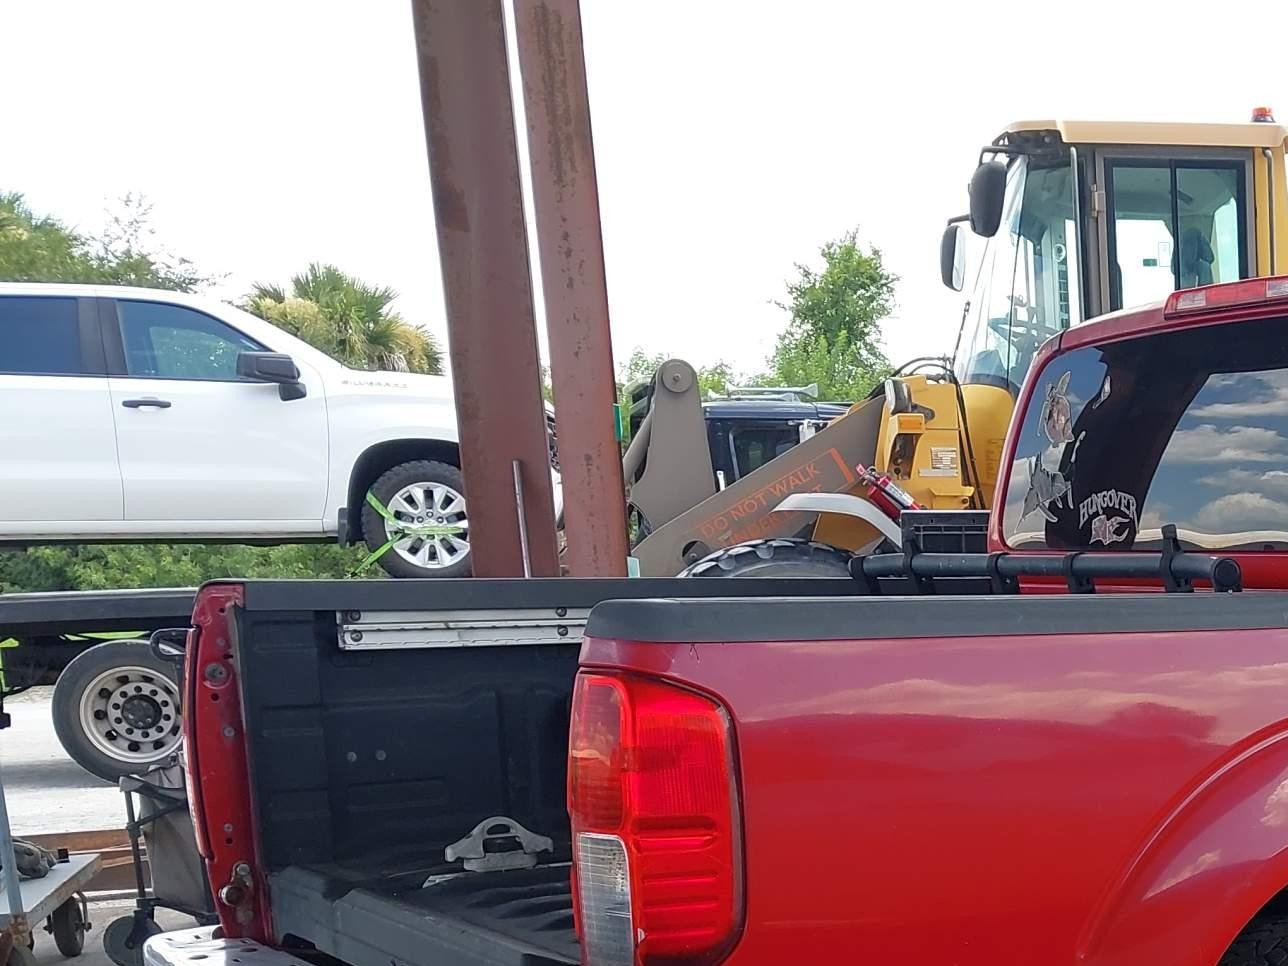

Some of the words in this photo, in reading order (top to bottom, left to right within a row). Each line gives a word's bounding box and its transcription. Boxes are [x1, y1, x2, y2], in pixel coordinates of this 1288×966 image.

[701, 516, 729, 538] DO
[731, 494, 768, 521] NOT
[768, 462, 821, 497] WALK
[1078, 488, 1139, 535] HUNGOVER
